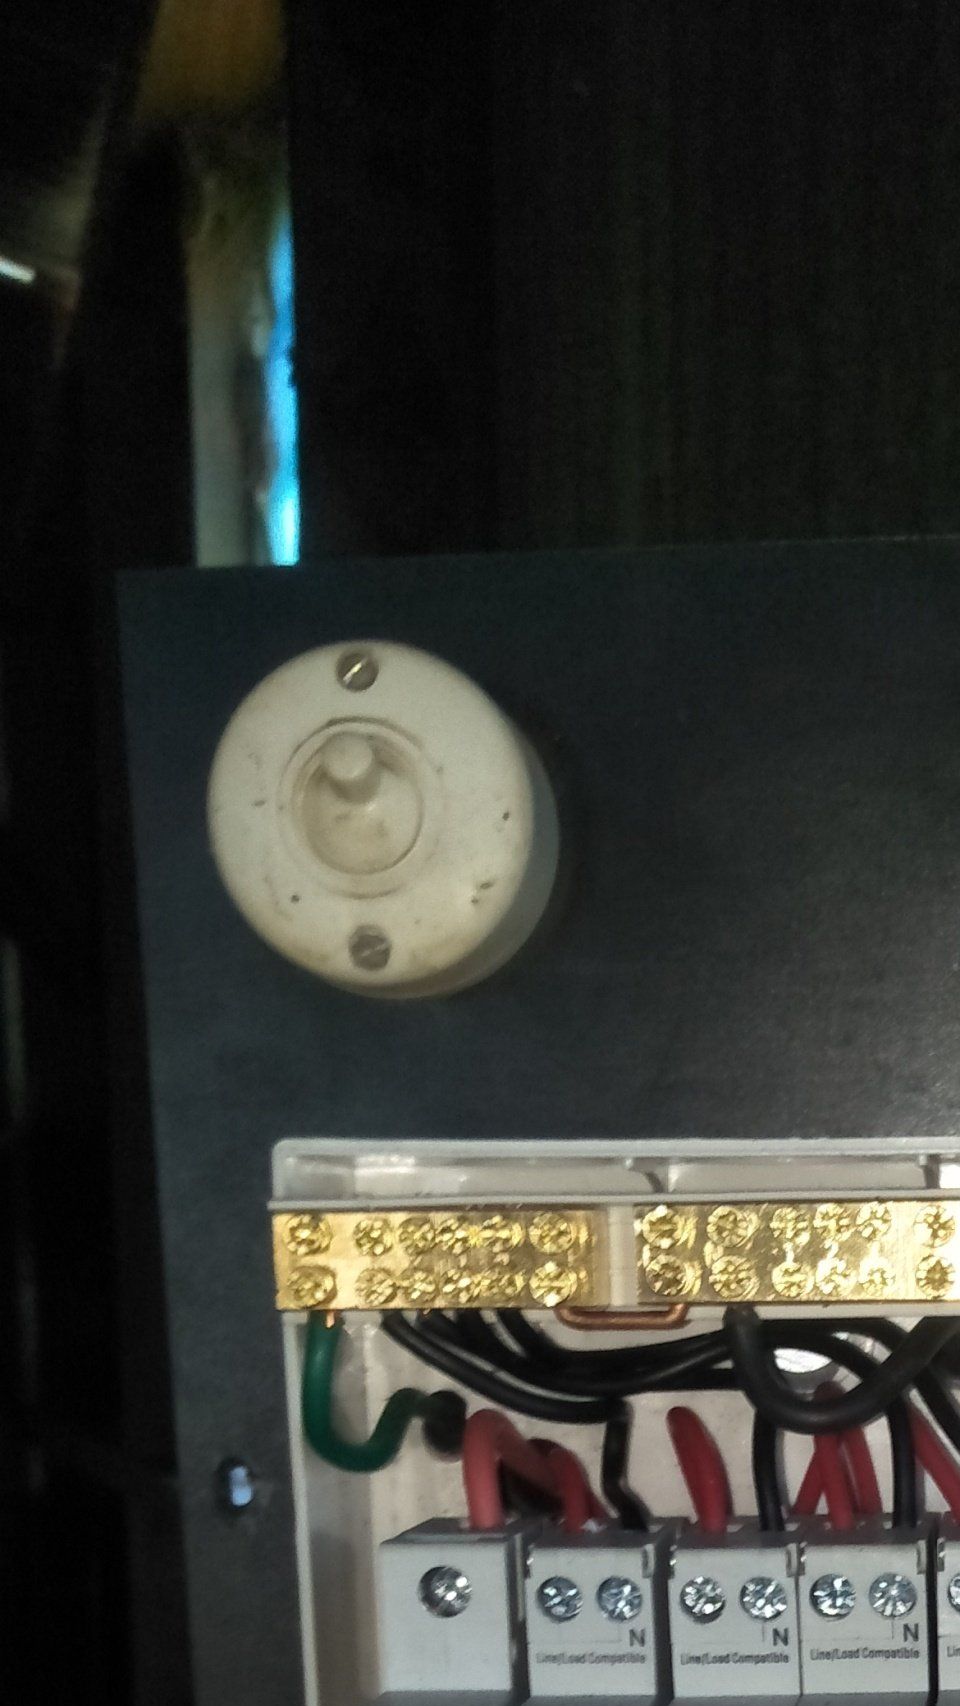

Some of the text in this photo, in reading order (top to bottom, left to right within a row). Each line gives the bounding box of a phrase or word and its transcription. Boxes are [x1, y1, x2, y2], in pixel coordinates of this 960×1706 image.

[629, 1628, 646, 1647] N
[772, 1628, 789, 1647] N
[902, 1622, 920, 1642] N
[732, 1652, 789, 1665] Compatible
[862, 1647, 920, 1660] Compatible
